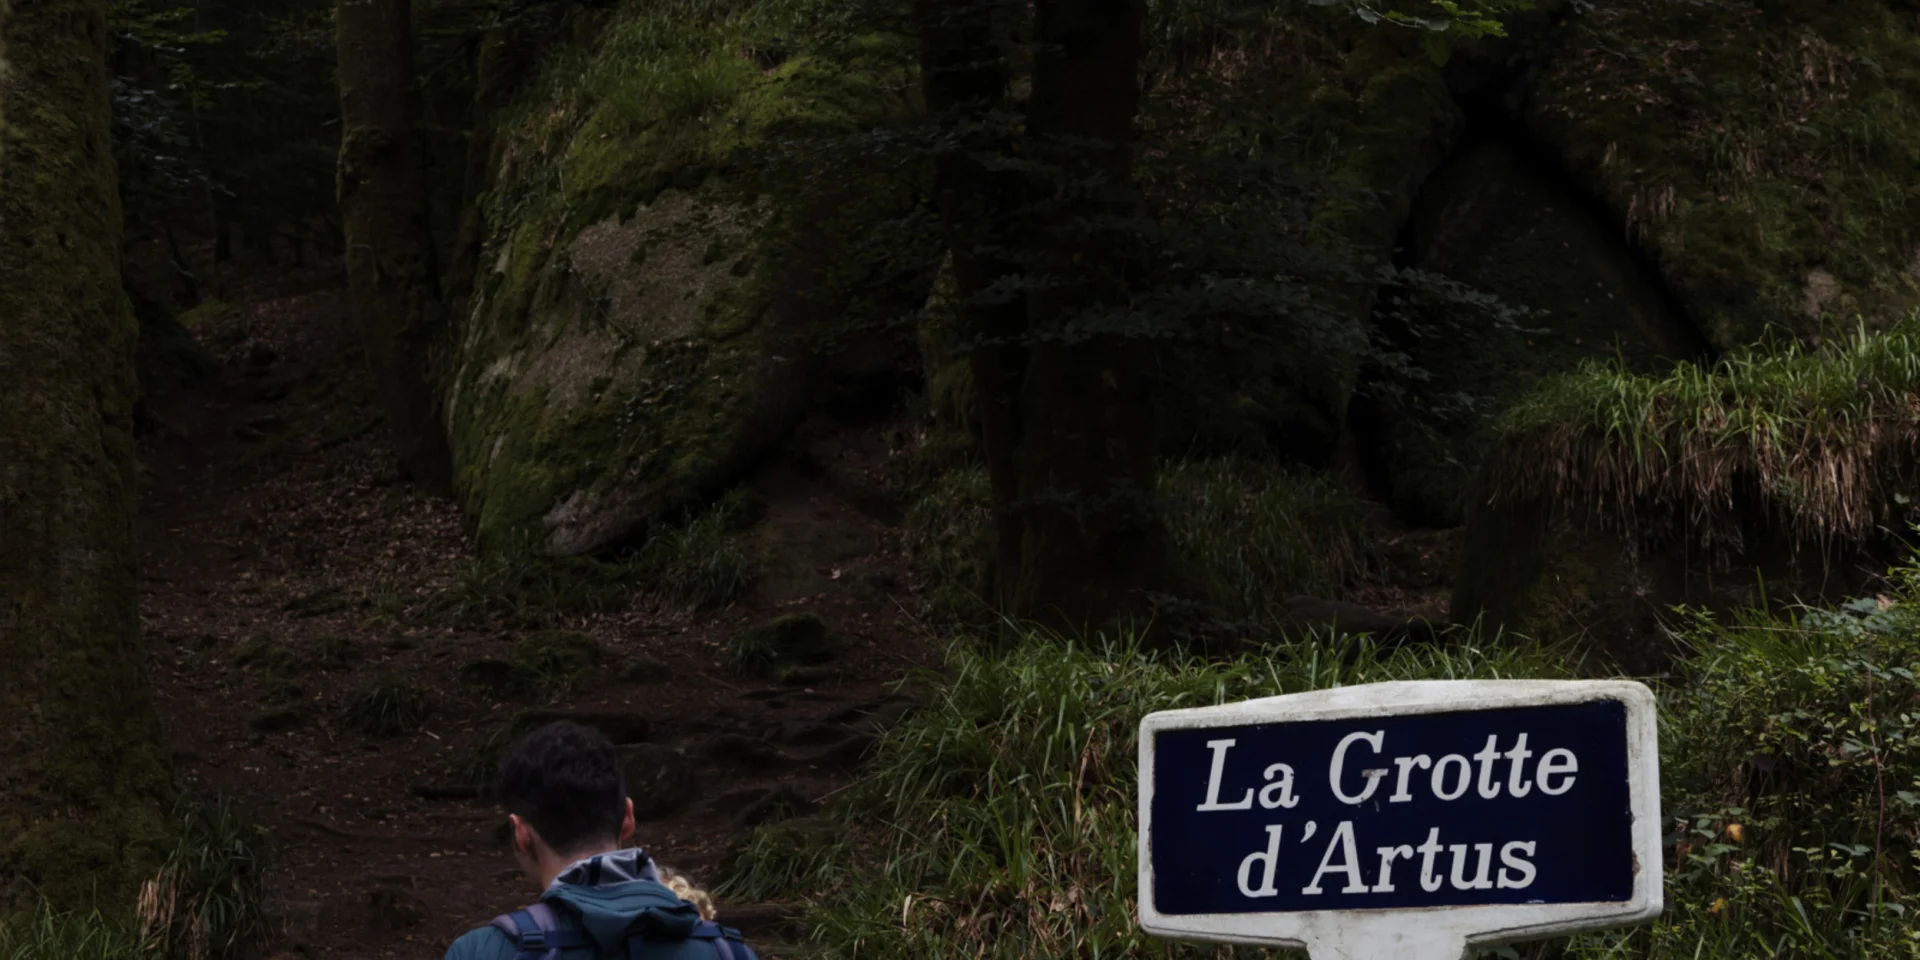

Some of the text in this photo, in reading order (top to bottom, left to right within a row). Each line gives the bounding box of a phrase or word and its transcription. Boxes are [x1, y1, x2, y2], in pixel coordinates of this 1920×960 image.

[1197, 730, 1579, 811] La Grotte
[1236, 820, 1537, 898] d'Artus
